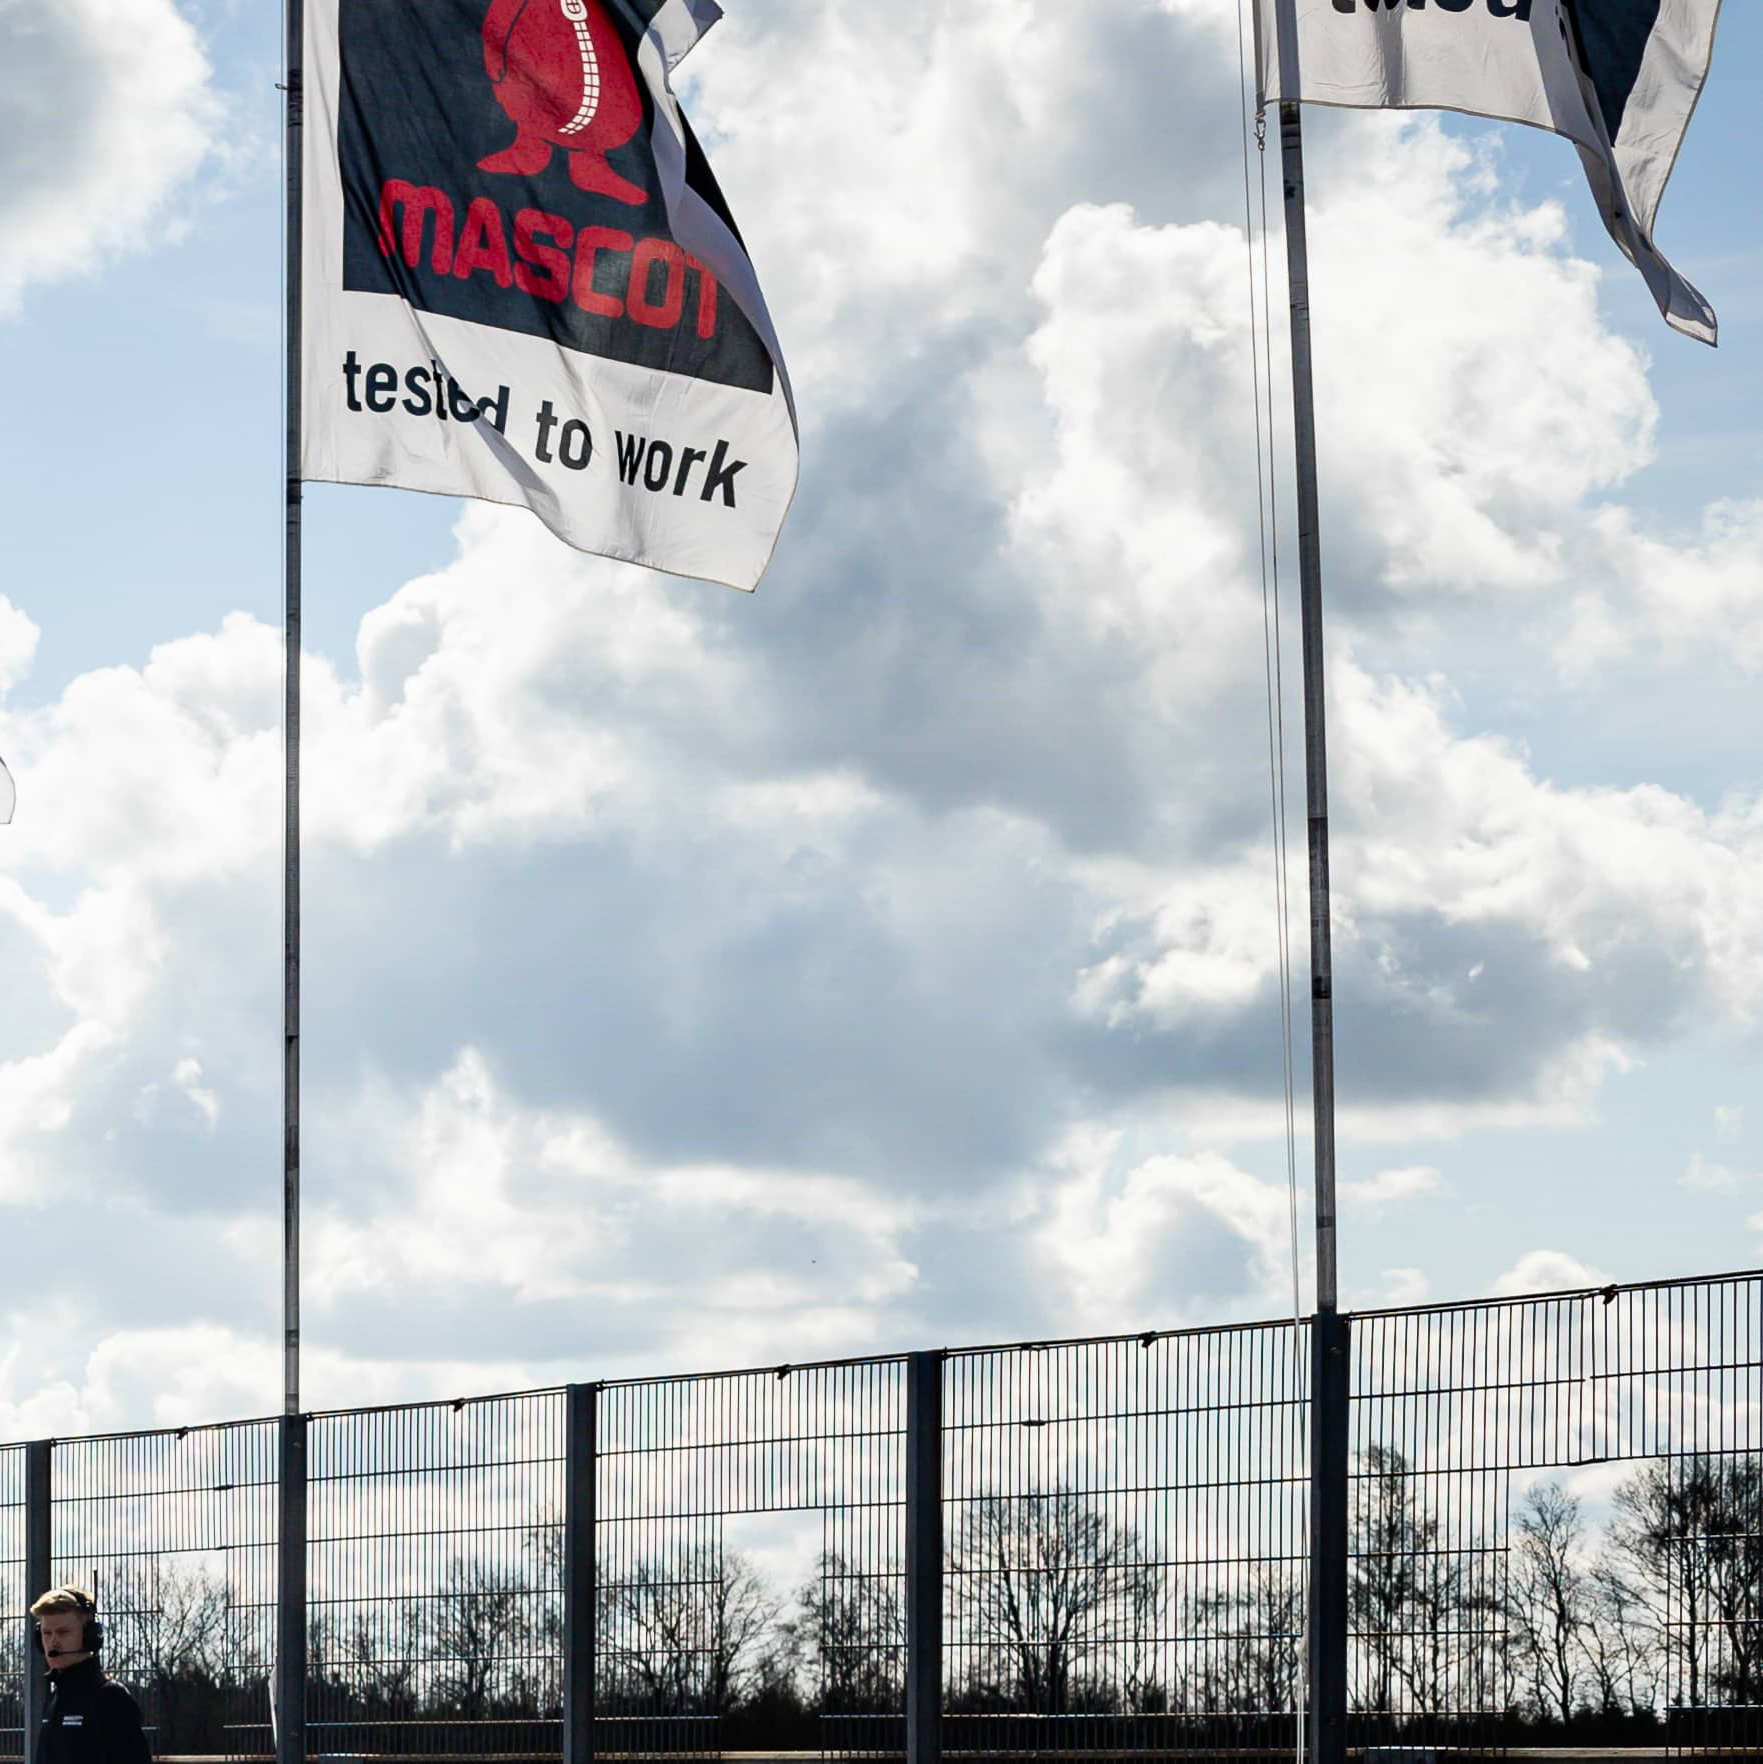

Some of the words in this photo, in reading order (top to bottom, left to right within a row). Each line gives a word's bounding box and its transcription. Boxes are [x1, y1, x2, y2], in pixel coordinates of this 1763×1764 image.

[379, 178, 723, 340] MASCOT
[342, 350, 510, 436] tested
[534, 399, 593, 471] to
[614, 429, 749, 508] work
